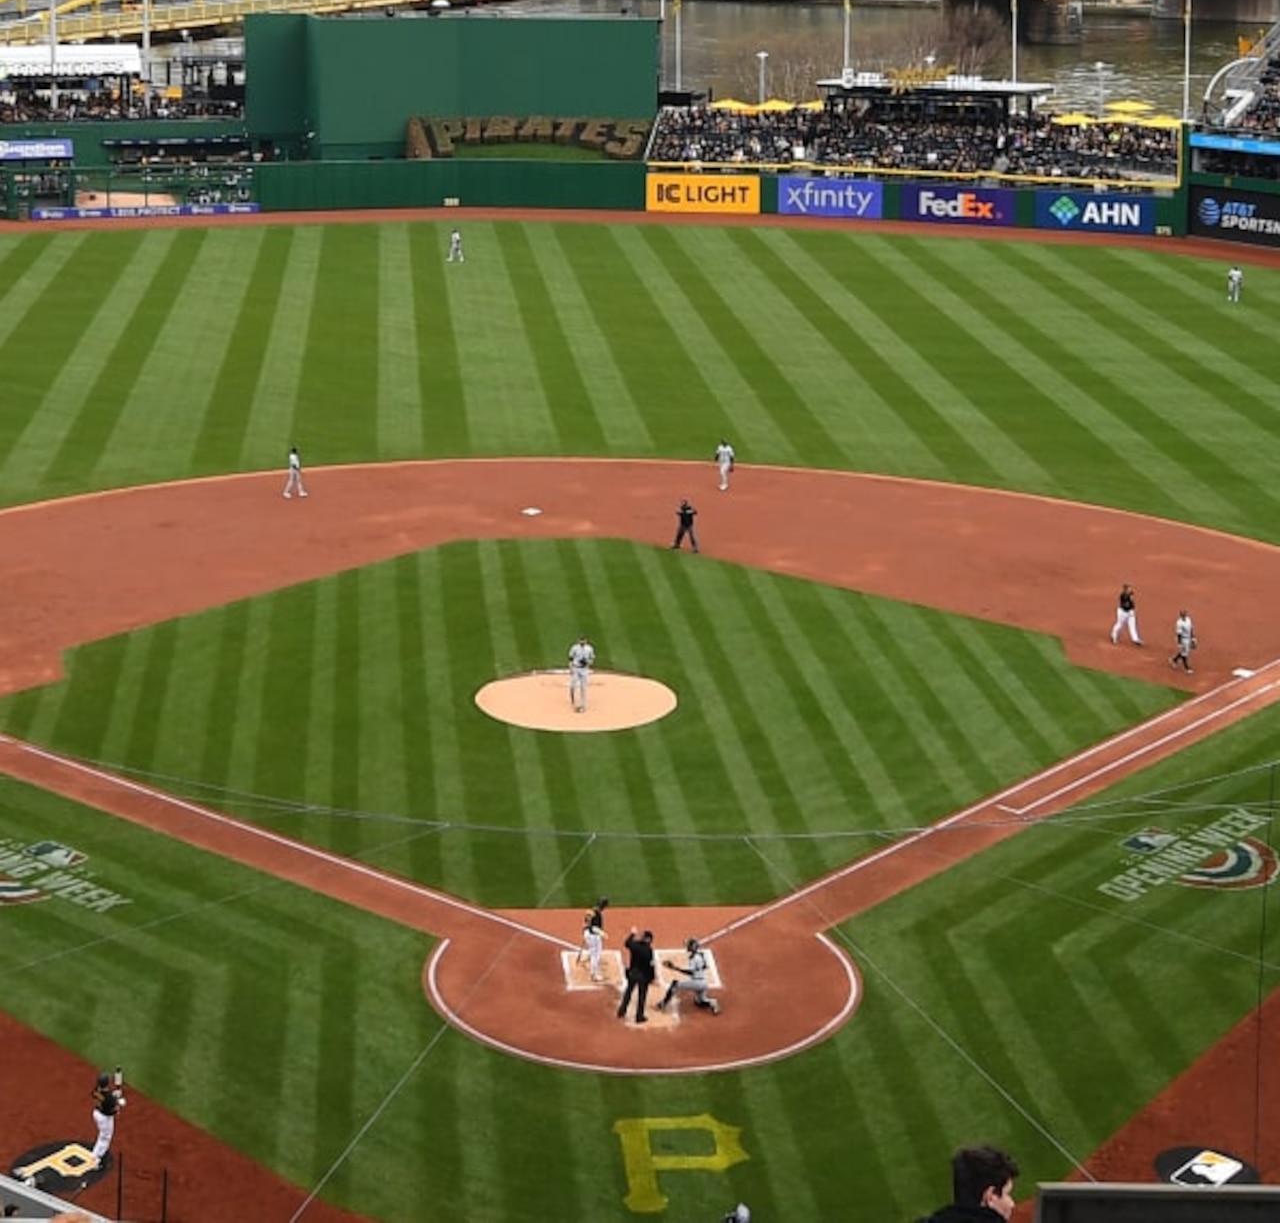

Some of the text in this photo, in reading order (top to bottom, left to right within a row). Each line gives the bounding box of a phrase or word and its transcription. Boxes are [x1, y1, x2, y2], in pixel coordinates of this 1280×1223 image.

[432, 119, 646, 158] PIRATES
[686, 185, 750, 203] LIGHT
[787, 181, 872, 215] xfinity
[919, 191, 994, 219] FedEx
[1222, 201, 1257, 217] AT&T
[1082, 202, 1140, 226] AHN
[1097, 807, 1274, 901] OPENING WEEK
[32, 871, 134, 913] WEEK
[614, 1114, 751, 1212] P
